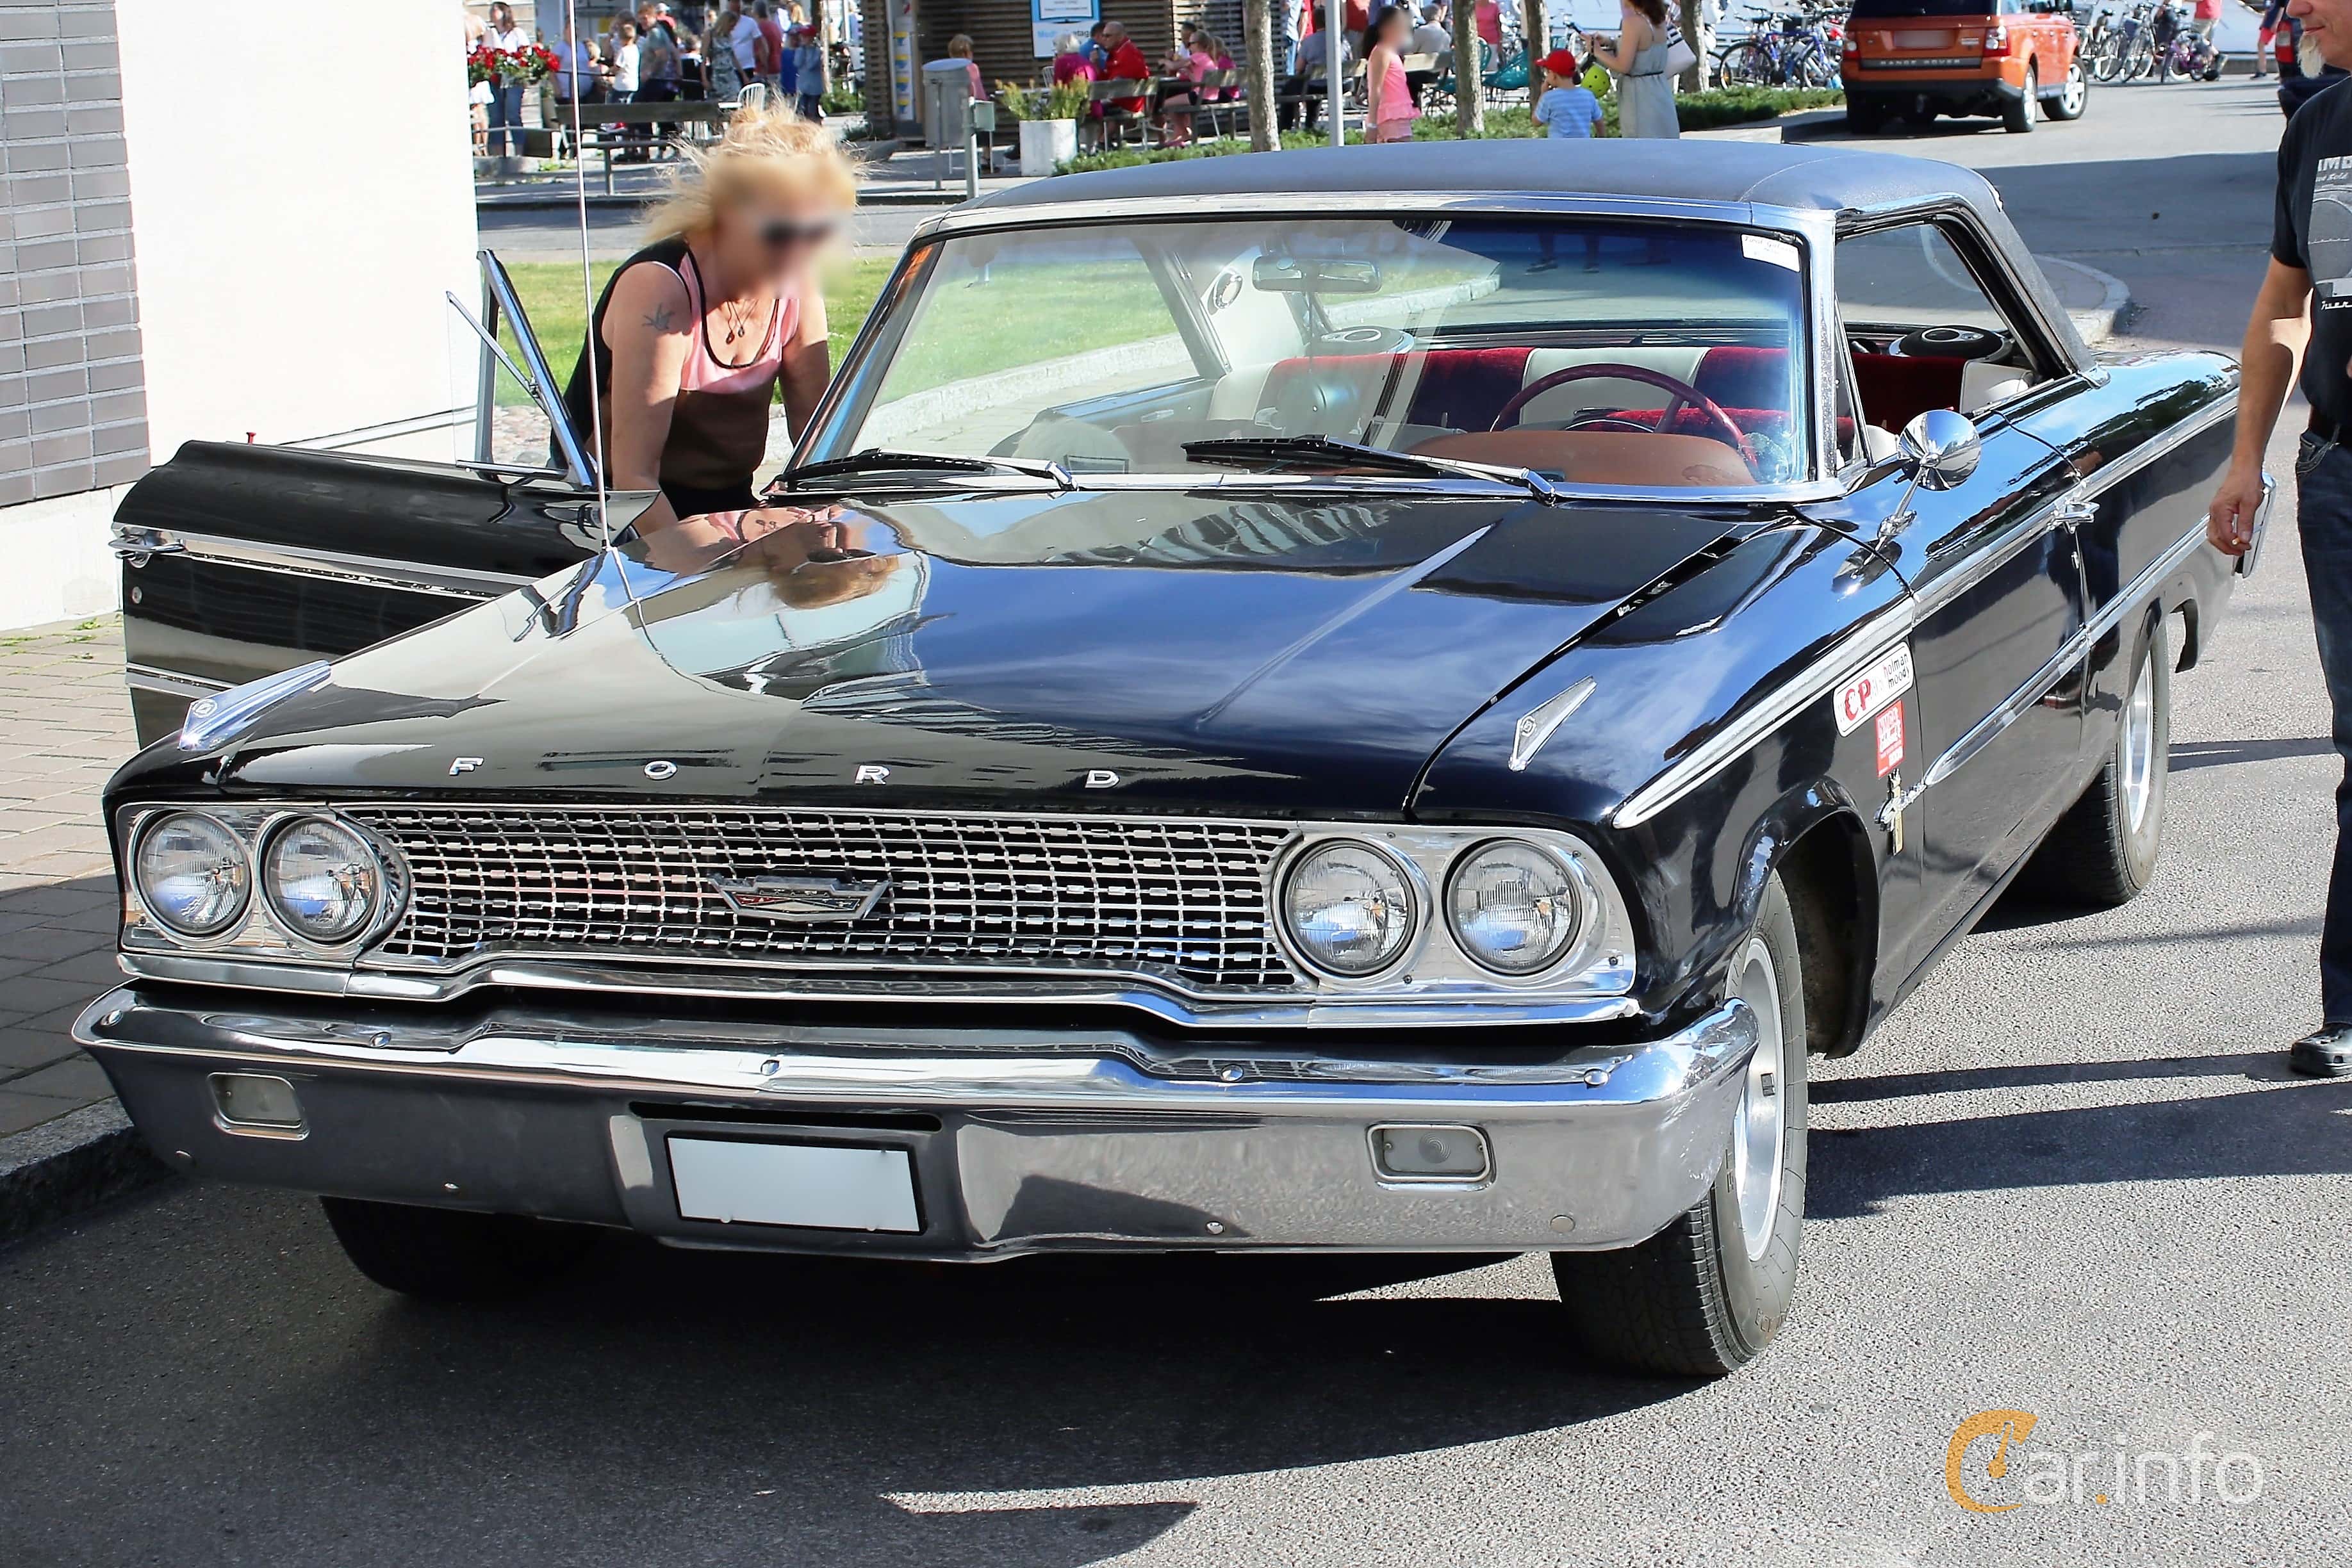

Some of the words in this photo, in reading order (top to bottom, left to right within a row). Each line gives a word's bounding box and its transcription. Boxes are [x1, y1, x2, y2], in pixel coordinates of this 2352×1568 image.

[1883, 653, 1909, 678] holman
[1887, 666, 1909, 689] moody
[1845, 679, 1871, 721] CP
[448, 756, 1121, 789] FORD
